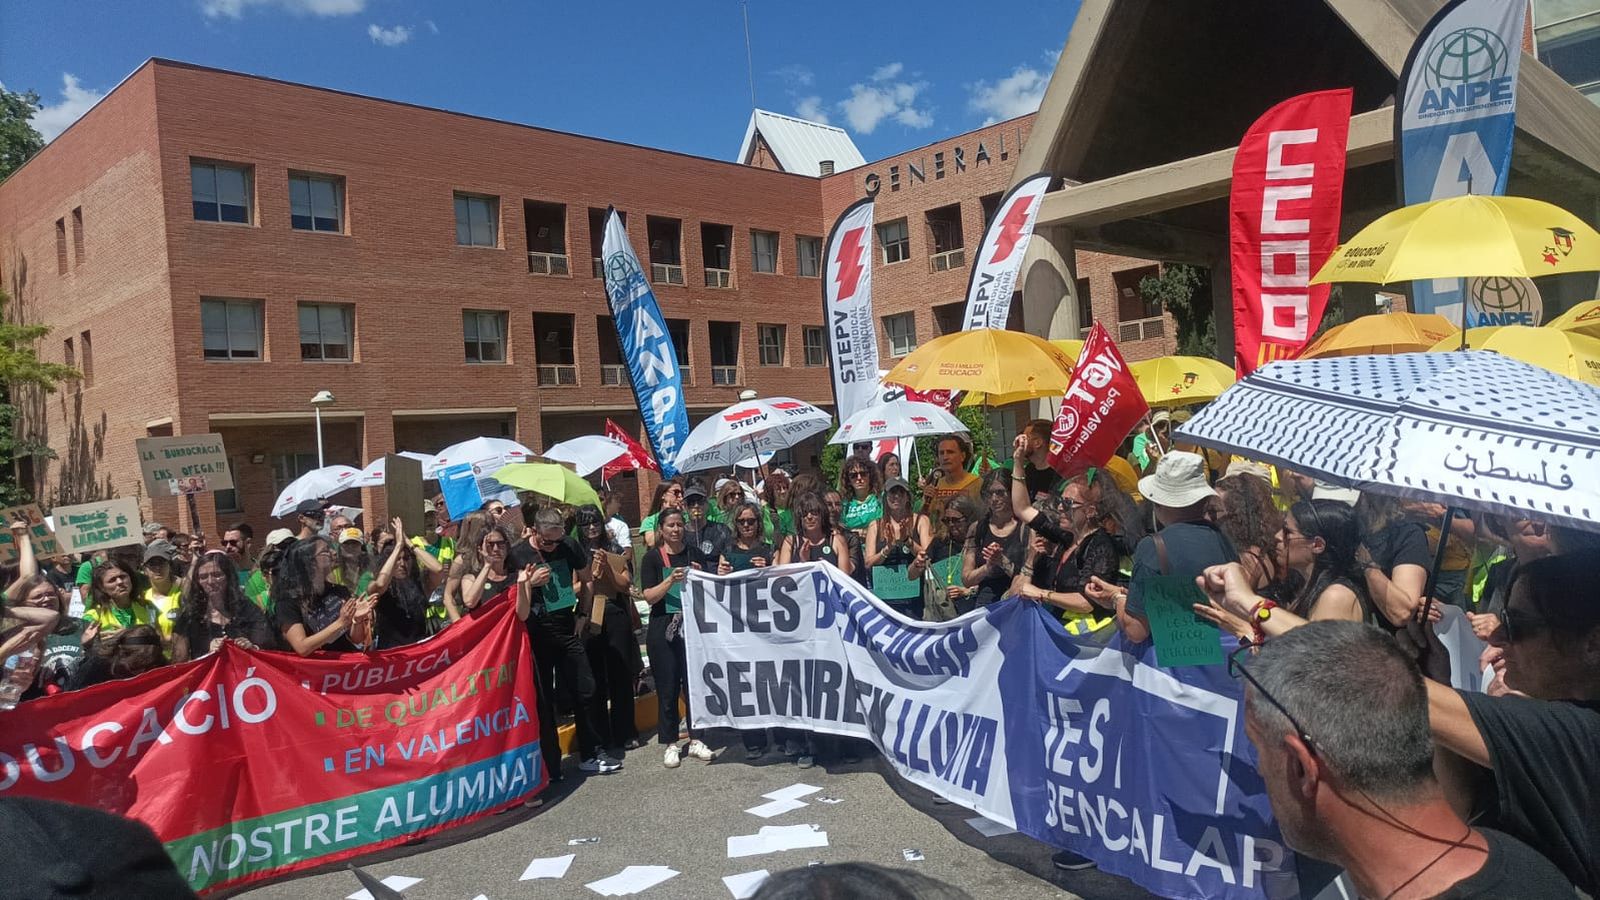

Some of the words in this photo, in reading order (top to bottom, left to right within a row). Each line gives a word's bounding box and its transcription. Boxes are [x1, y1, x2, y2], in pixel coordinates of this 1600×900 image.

[1418, 76, 1512, 113] ANPE
[1418, 109, 1455, 119] SINDICATO
[1456, 100, 1512, 113] INDEPENDIENTE
[865, 127, 1022, 191] GENERALI
[1260, 128, 1318, 341] CCOO
[970, 272, 995, 328] TEPV
[1478, 312, 1533, 327] ANPE
[833, 311, 856, 384] STEPV
[850, 306, 866, 381] INTERSINDICAL
[730, 413, 768, 430] STEPV
[784, 406, 815, 417] STEPV
[1443, 444, 1574, 491] فلسطين
[692, 576, 801, 634] L'IES
[321, 648, 452, 696] PÚBLICA
[336, 706, 375, 729] DE
[345, 743, 386, 774] EN
[397, 696, 530, 760] VALENCIÀ
[1044, 691, 1110, 784] IES
[187, 805, 360, 882] NOSTRE
[374, 750, 542, 833] ALUMNAT
